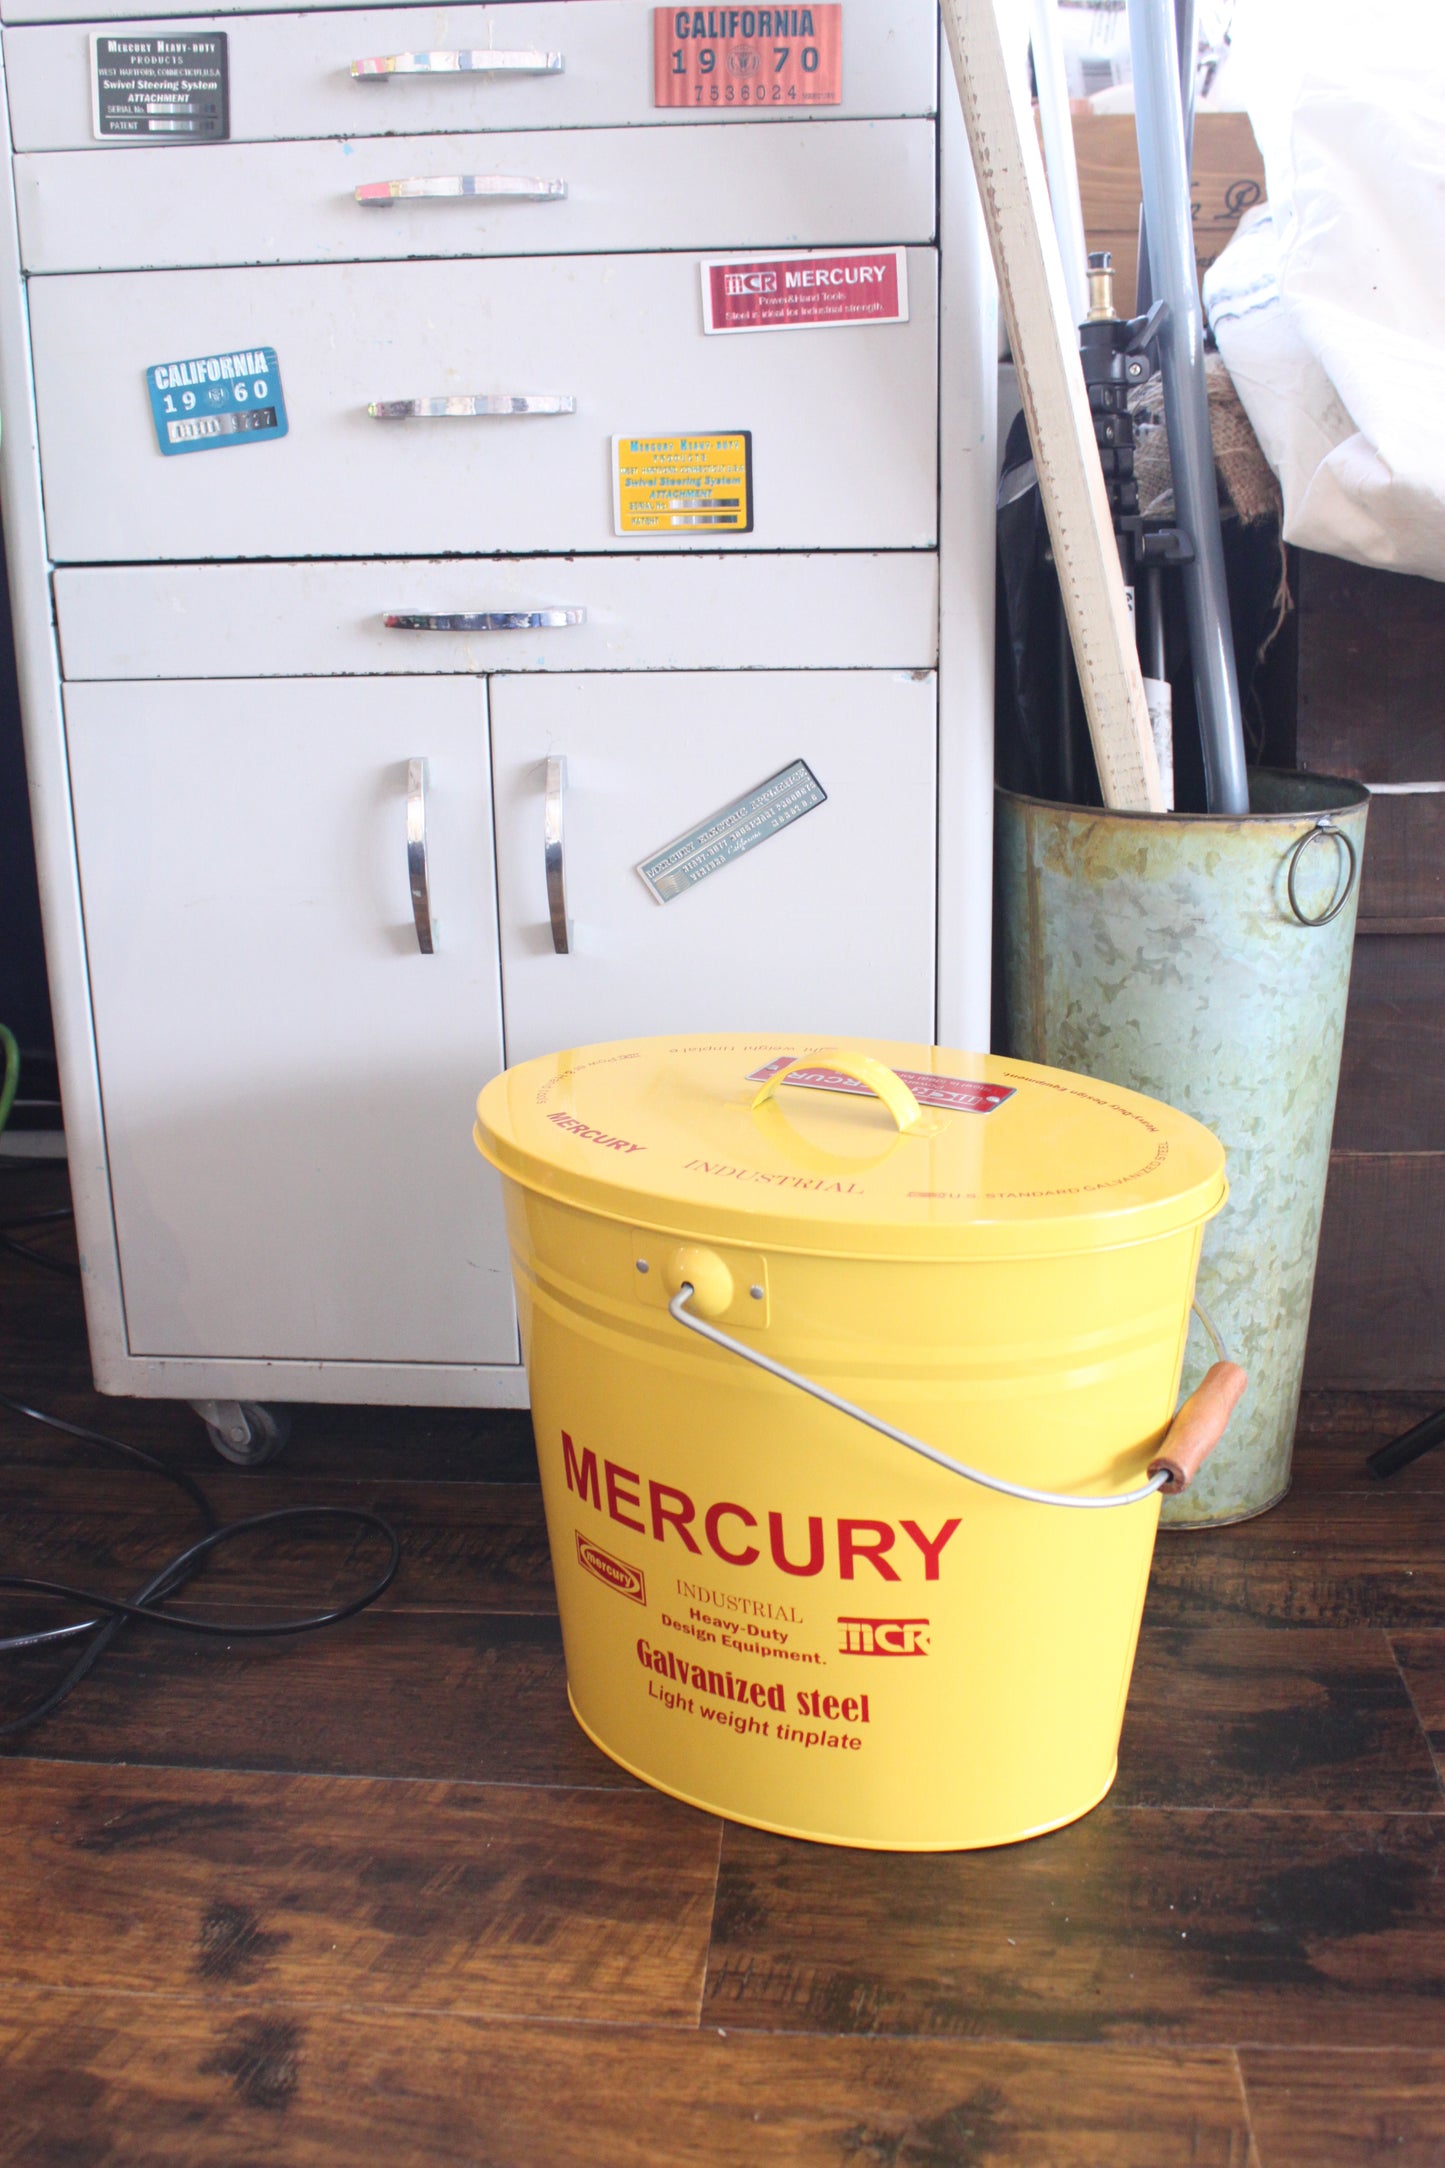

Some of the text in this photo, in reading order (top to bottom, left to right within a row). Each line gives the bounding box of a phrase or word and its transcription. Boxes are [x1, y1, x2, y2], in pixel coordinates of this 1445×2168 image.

[675, 9, 814, 39] CALIFORNIA
[131, 56, 183, 64] PRODUCTS
[104, 80, 218, 91] Swivel Steering System
[128, 94, 190, 103] ATTACHMENT
[694, 84, 796, 101] 7536024
[107, 105, 132, 113] SERIAL
[110, 122, 138, 130] PATENT
[785, 265, 886, 289] MERCURY
[154, 351, 269, 390] CALIFORNIA
[649, 489, 712, 499] ATTACHMENT
[1070, 1091, 1107, 1105] Design
[546, 1112, 648, 1154] MERCURY
[684, 1159, 864, 1195] INDUSTRIAL
[986, 1187, 1080, 1199] STANDARD
[561, 1430, 962, 1582] MERCURY
[586, 1550, 632, 1588] mercury
[677, 1579, 803, 1623] INDUSTRIAL
[662, 1614, 827, 1665] Design Equipment.
[690, 1608, 788, 1644] Heavy-Duty
[637, 1638, 870, 1723] Galvanized steel
[648, 1680, 862, 1750] Light weight tinplate
